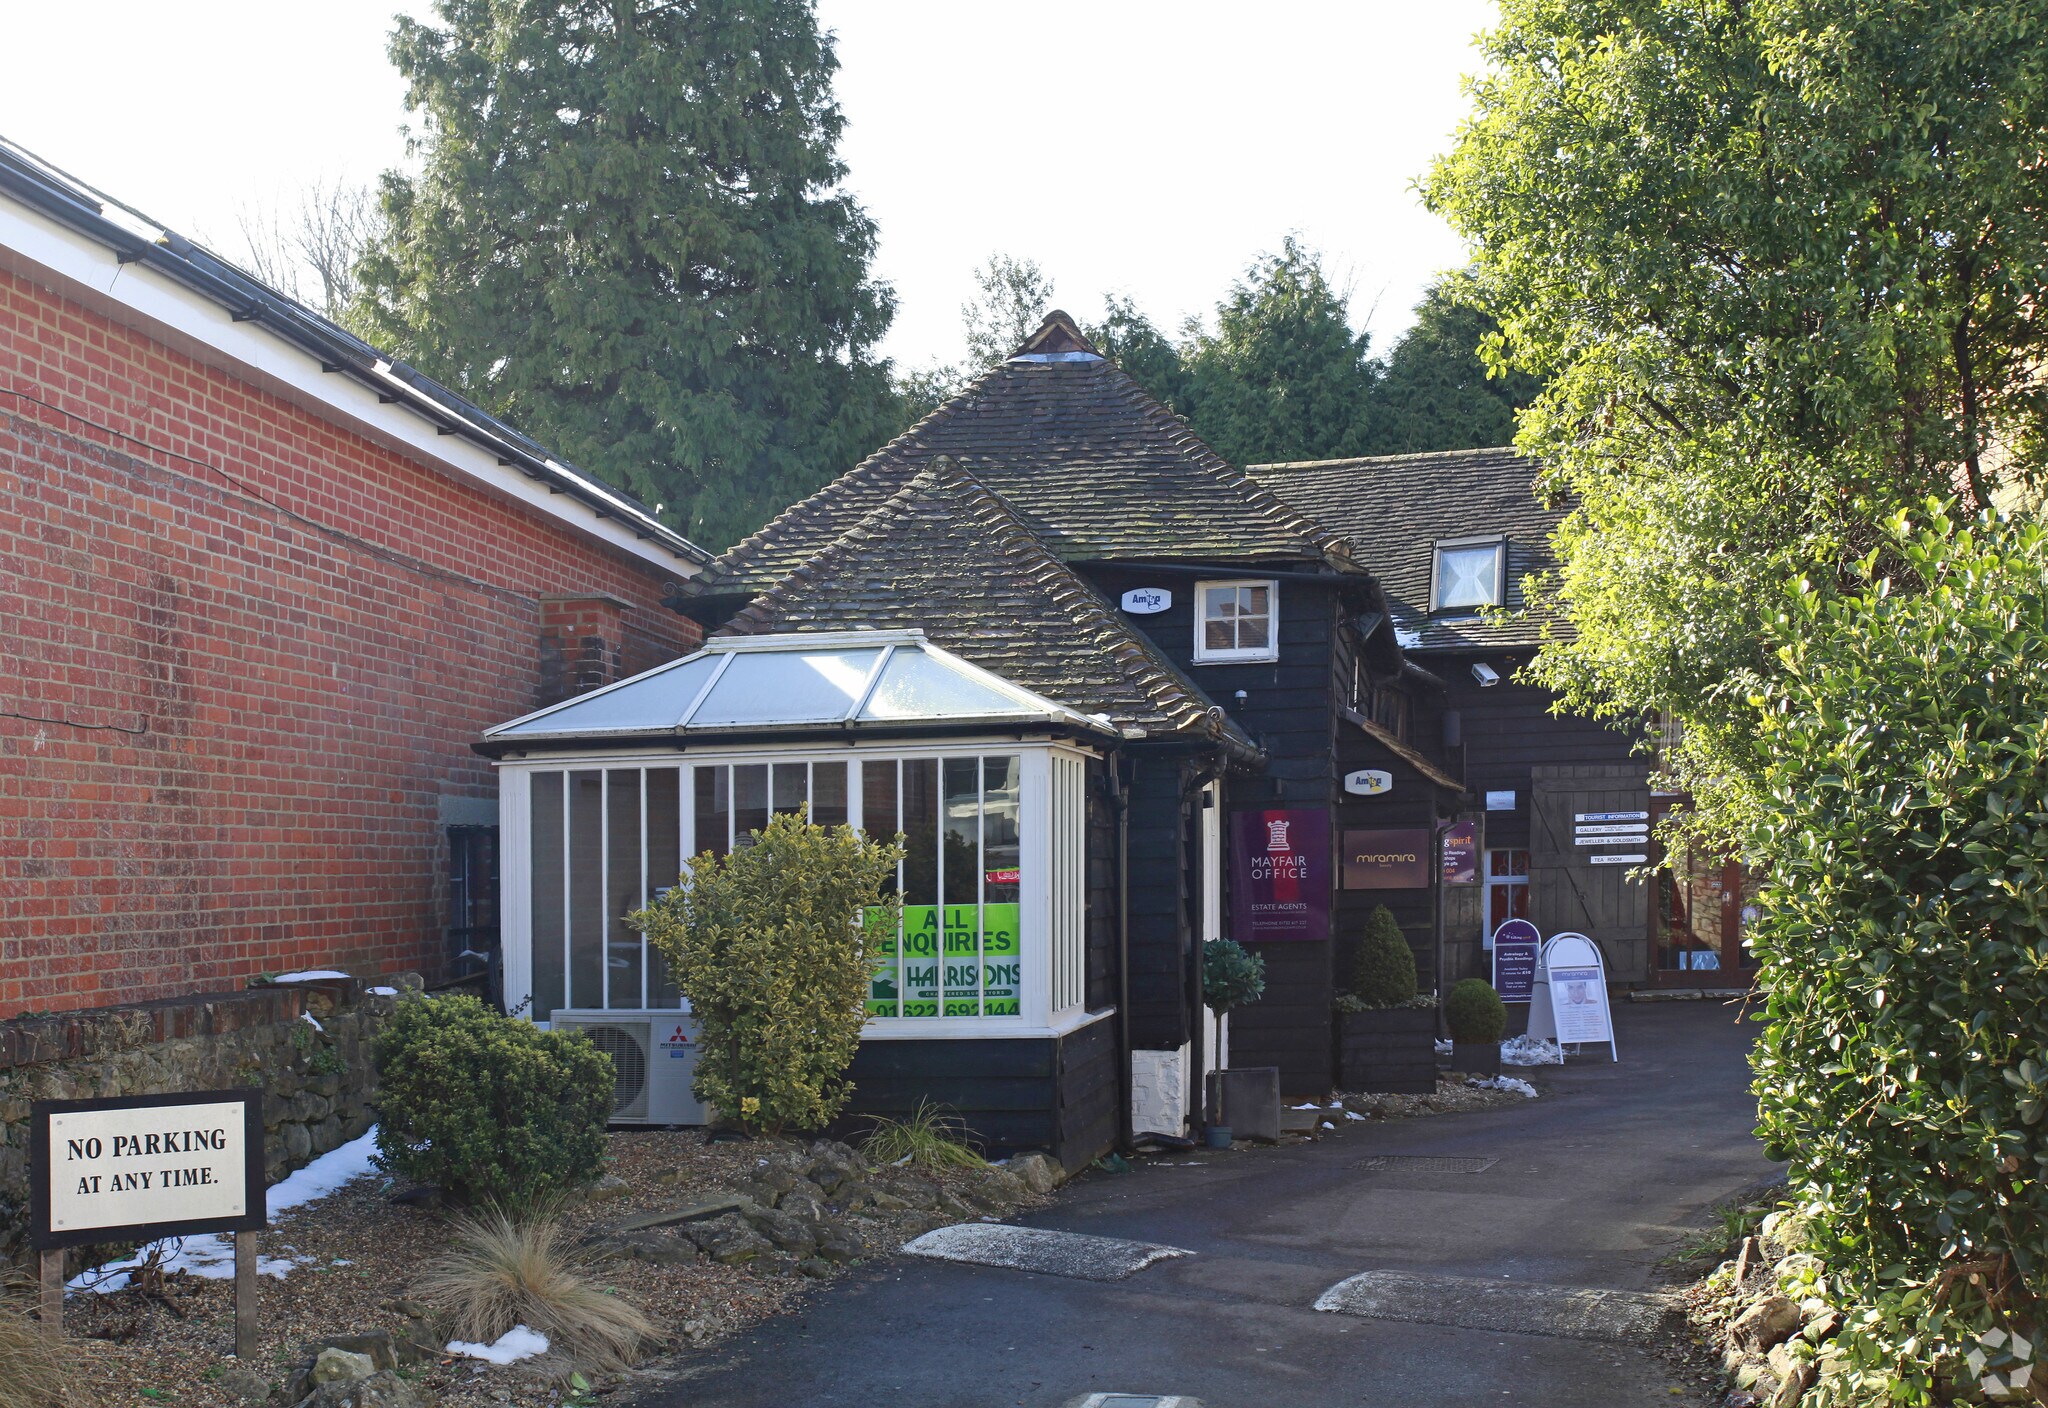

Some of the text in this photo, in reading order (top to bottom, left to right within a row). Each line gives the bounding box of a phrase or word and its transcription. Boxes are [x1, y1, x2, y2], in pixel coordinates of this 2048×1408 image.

[1251, 855, 1307, 867] MAYFAIR
[1356, 854, 1416, 863] miramira
[1251, 868, 1307, 879] OFFICE
[1278, 902, 1307, 910] AGENTS
[923, 910, 968, 929] ALL
[881, 931, 1011, 955] ENQUIRIES
[906, 963, 1020, 987] HARRISONS
[876, 1002, 1020, 1017] 01622 692144
[67, 1128, 226, 1160] NO PARKING
[76, 1167, 219, 1194] AT ANY TIME.
